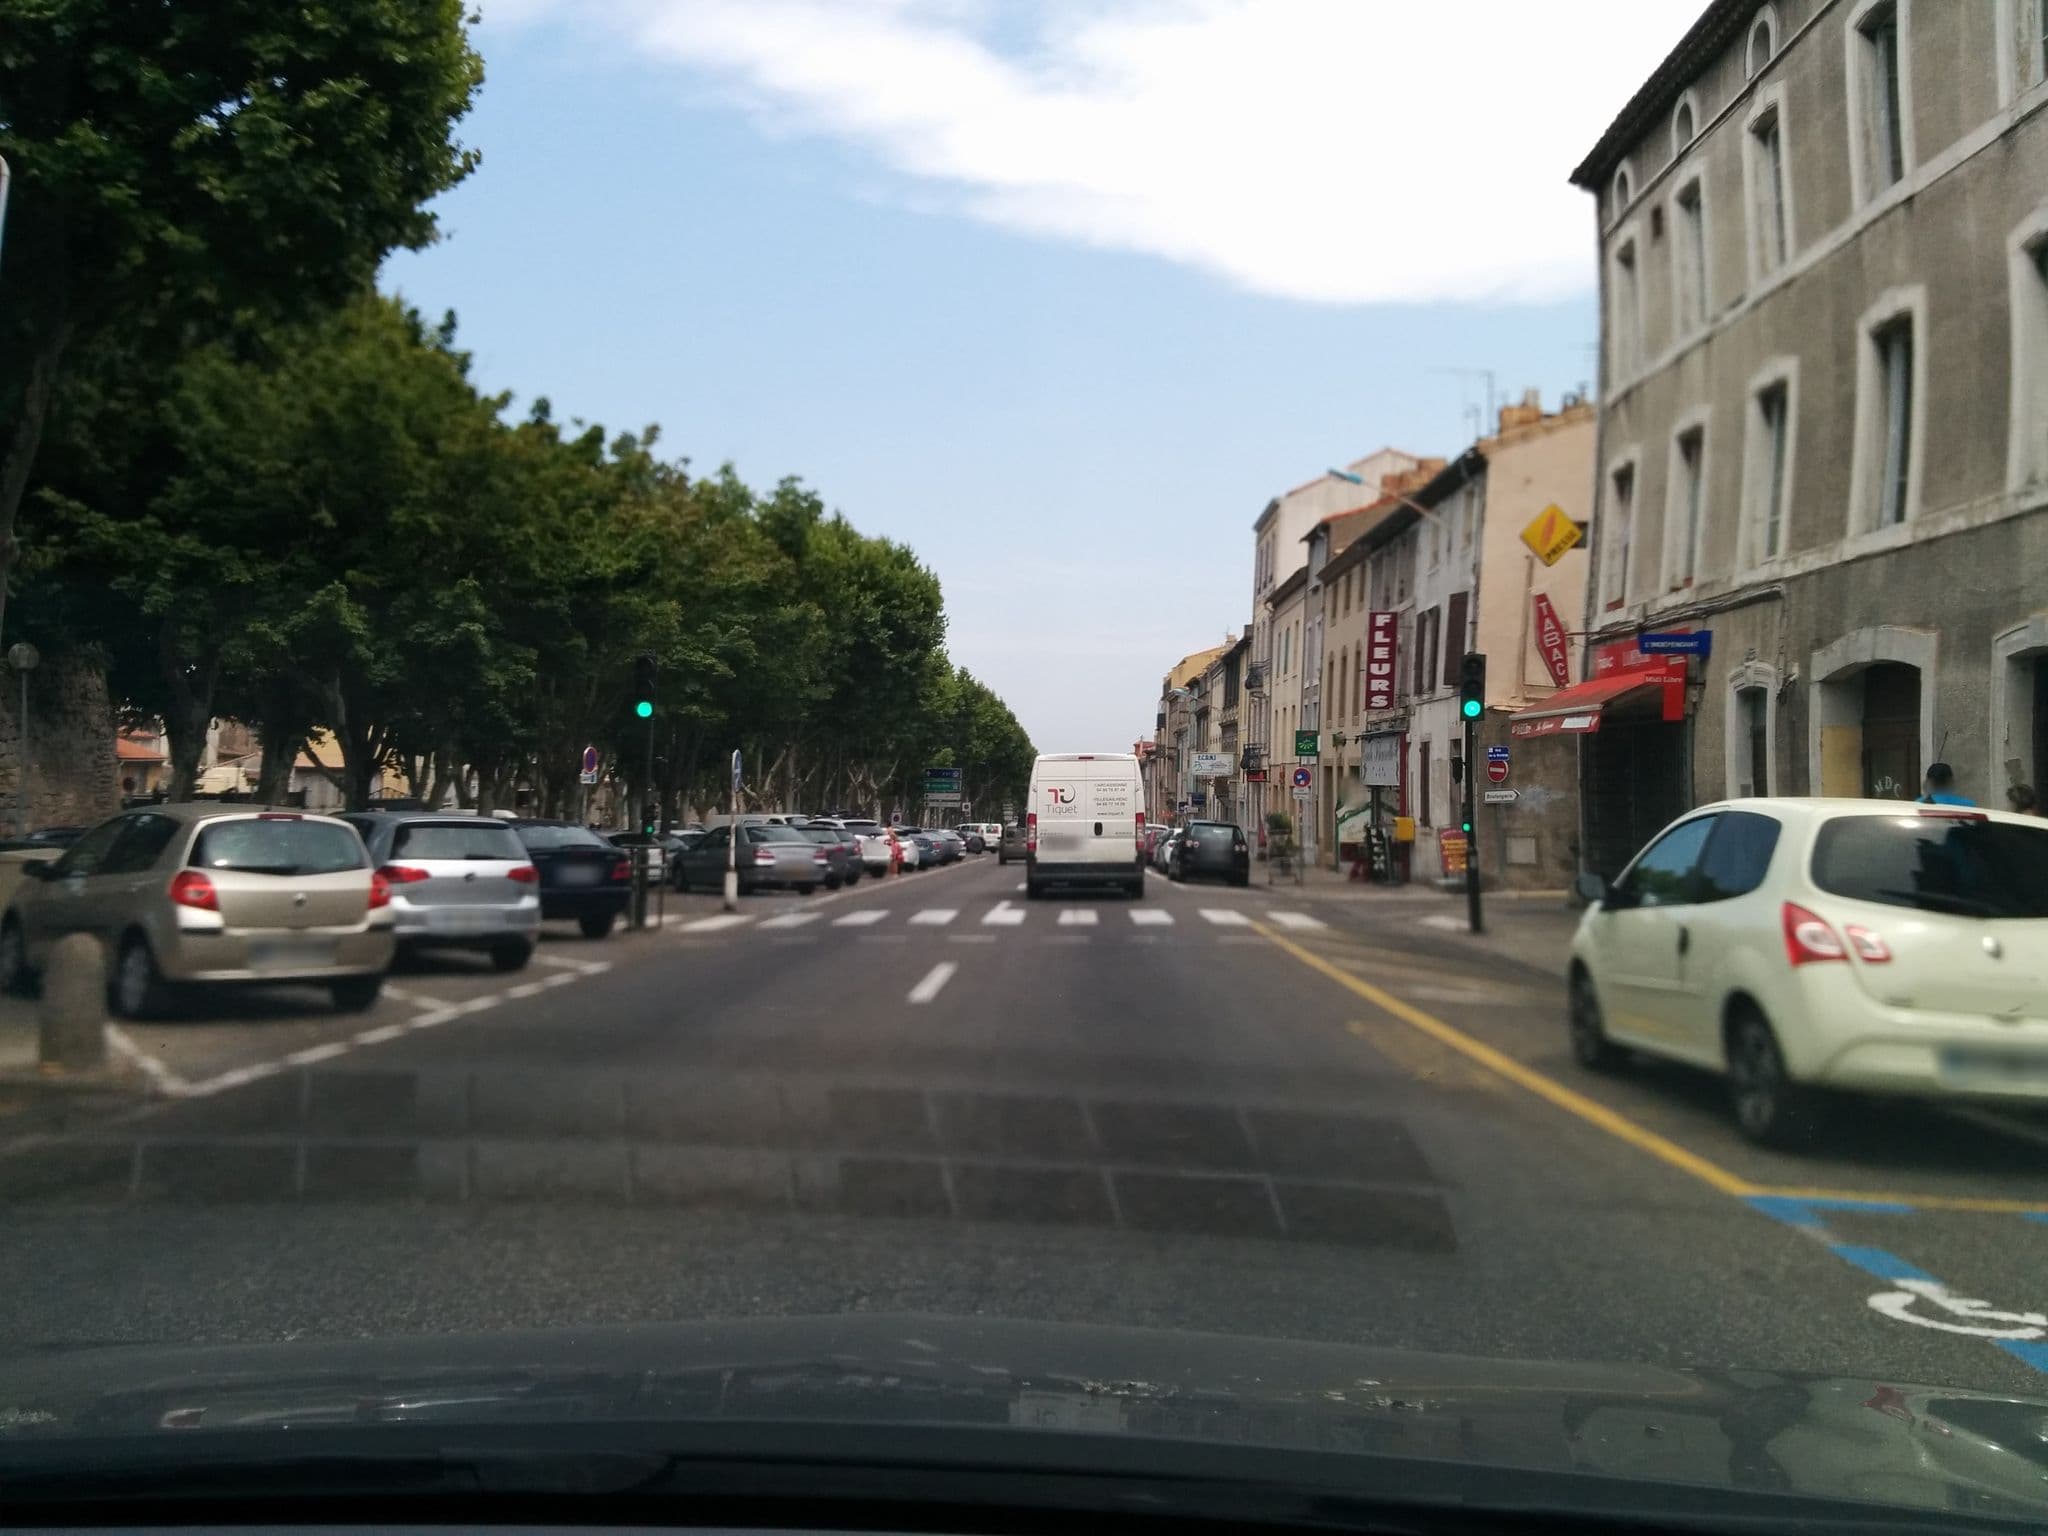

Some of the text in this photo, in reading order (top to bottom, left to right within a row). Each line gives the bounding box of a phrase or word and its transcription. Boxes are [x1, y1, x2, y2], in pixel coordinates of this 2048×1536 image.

[1370, 614, 1392, 708] FLEURS
[1538, 601, 1566, 677] TABAC
[1044, 804, 1078, 815] Tiquet
